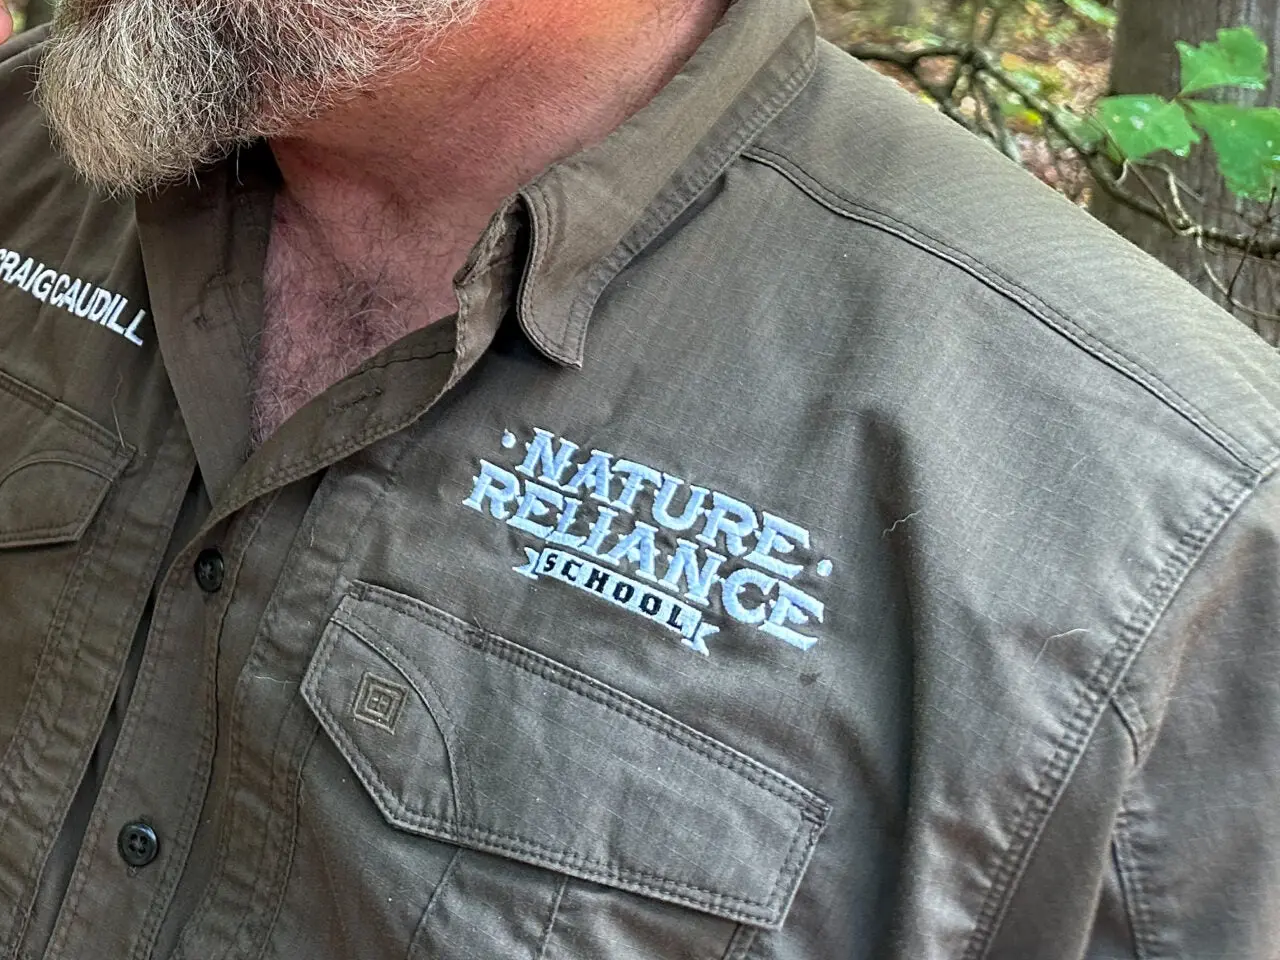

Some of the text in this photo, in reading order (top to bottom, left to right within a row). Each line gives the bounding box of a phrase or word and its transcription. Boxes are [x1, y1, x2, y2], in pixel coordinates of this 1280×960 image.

[462, 459, 824, 651] RELIANCE
[516, 427, 810, 579] NATURE
[542, 552, 685, 631] SCHOOL
